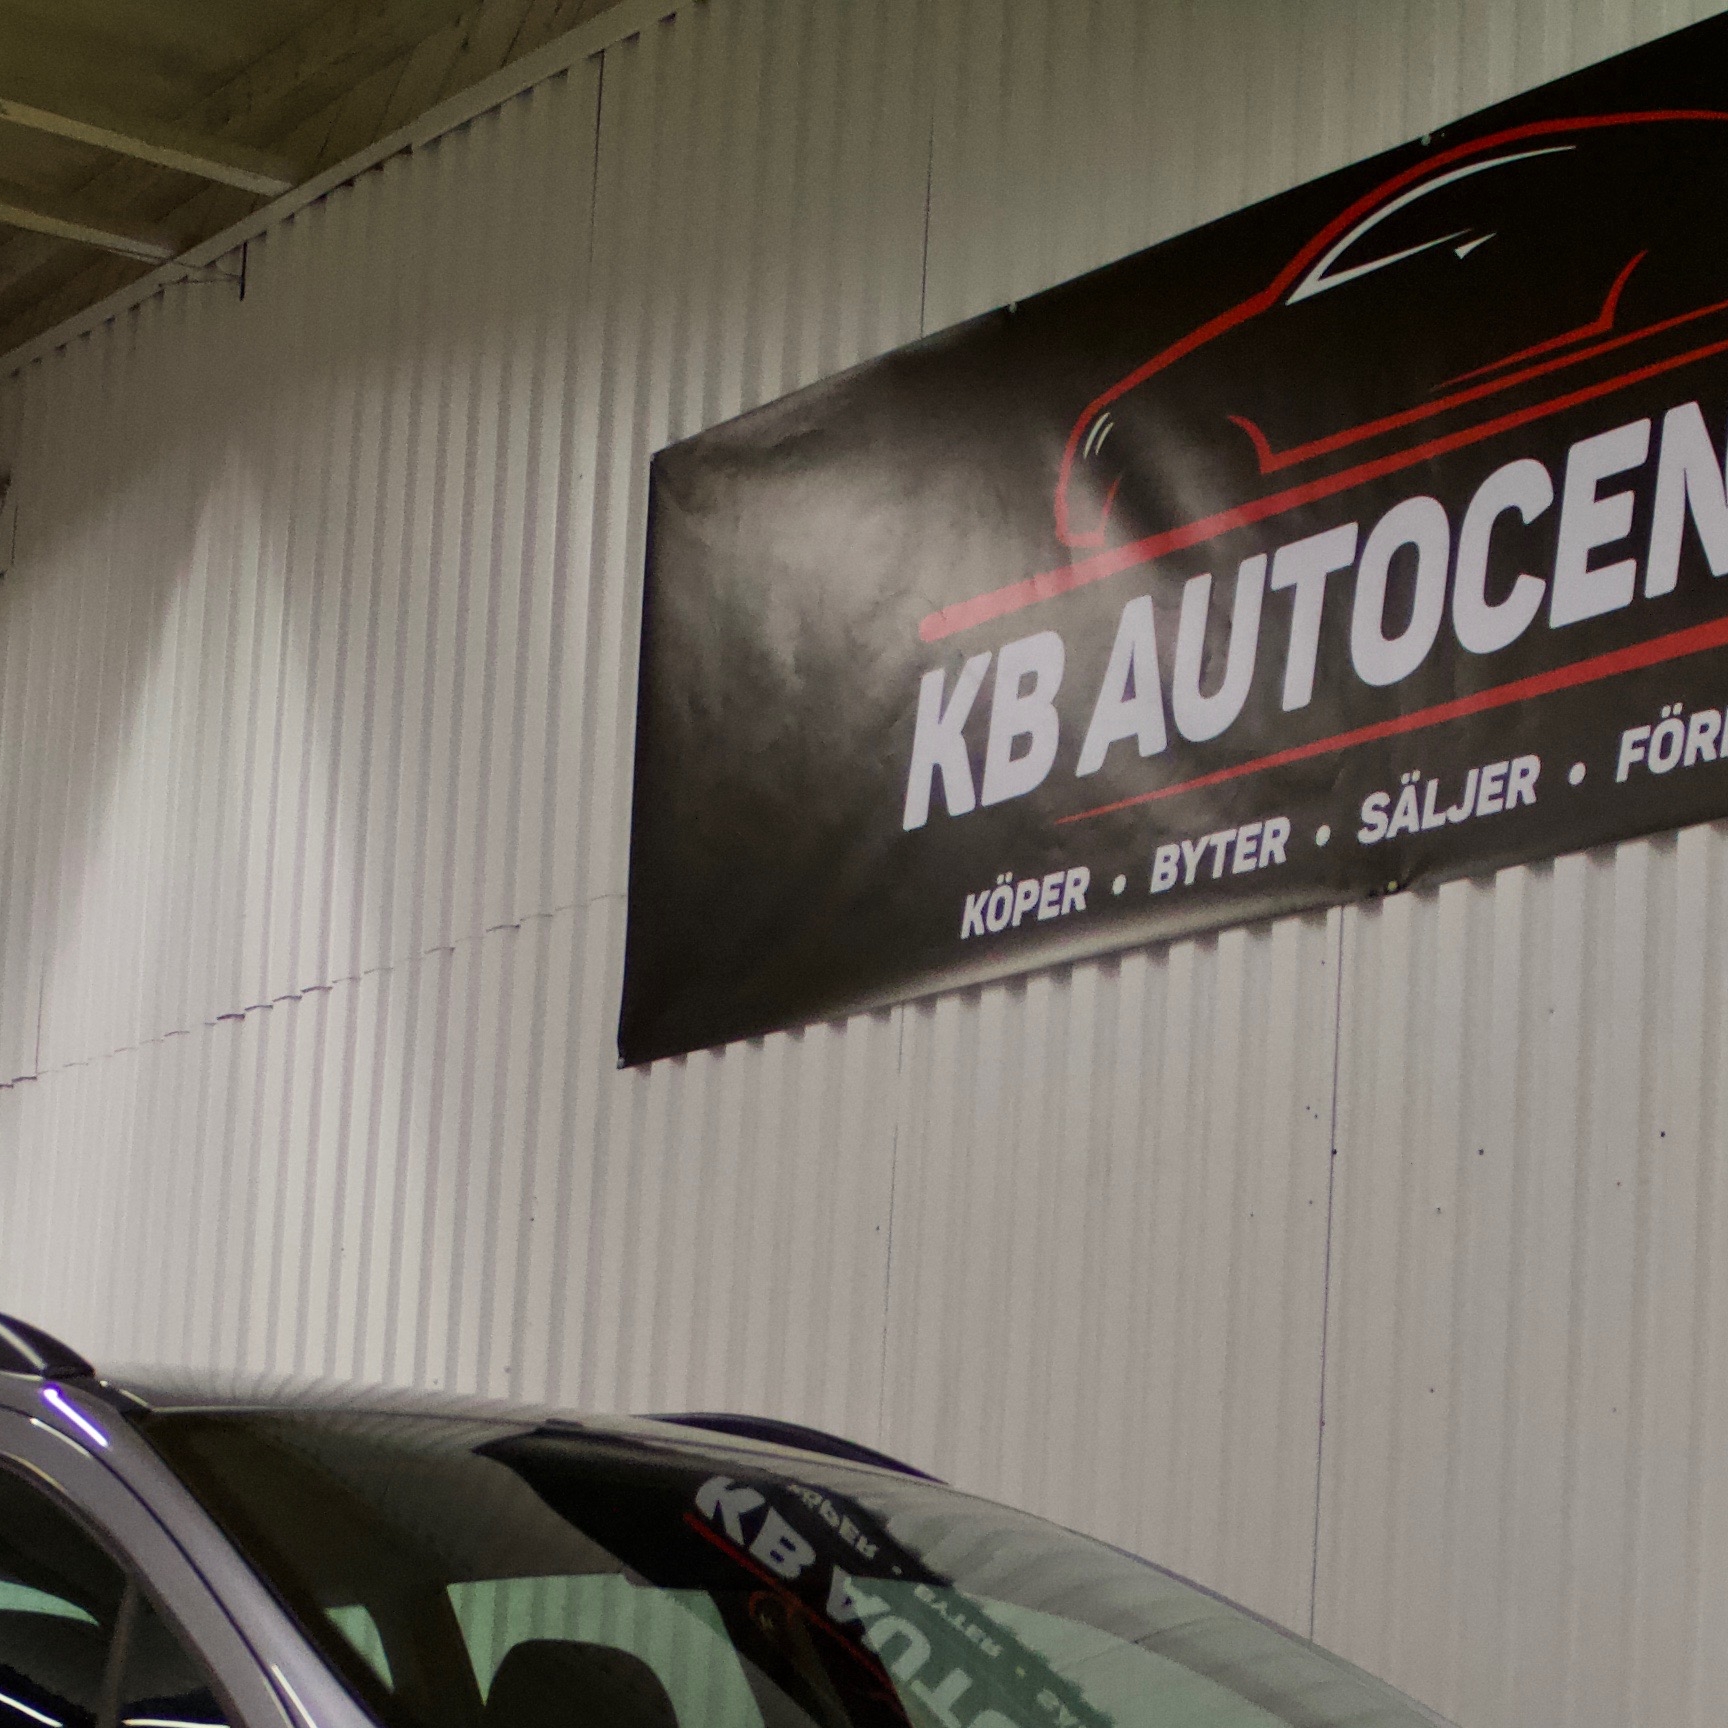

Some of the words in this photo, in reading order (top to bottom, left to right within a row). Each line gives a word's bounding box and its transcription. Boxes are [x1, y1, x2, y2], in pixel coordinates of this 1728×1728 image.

[903, 630, 1065, 831] KB
[960, 866, 1090, 939] KÖPER
[1150, 817, 1290, 893] BYTER
[1358, 754, 1541, 845] SÄLJER
